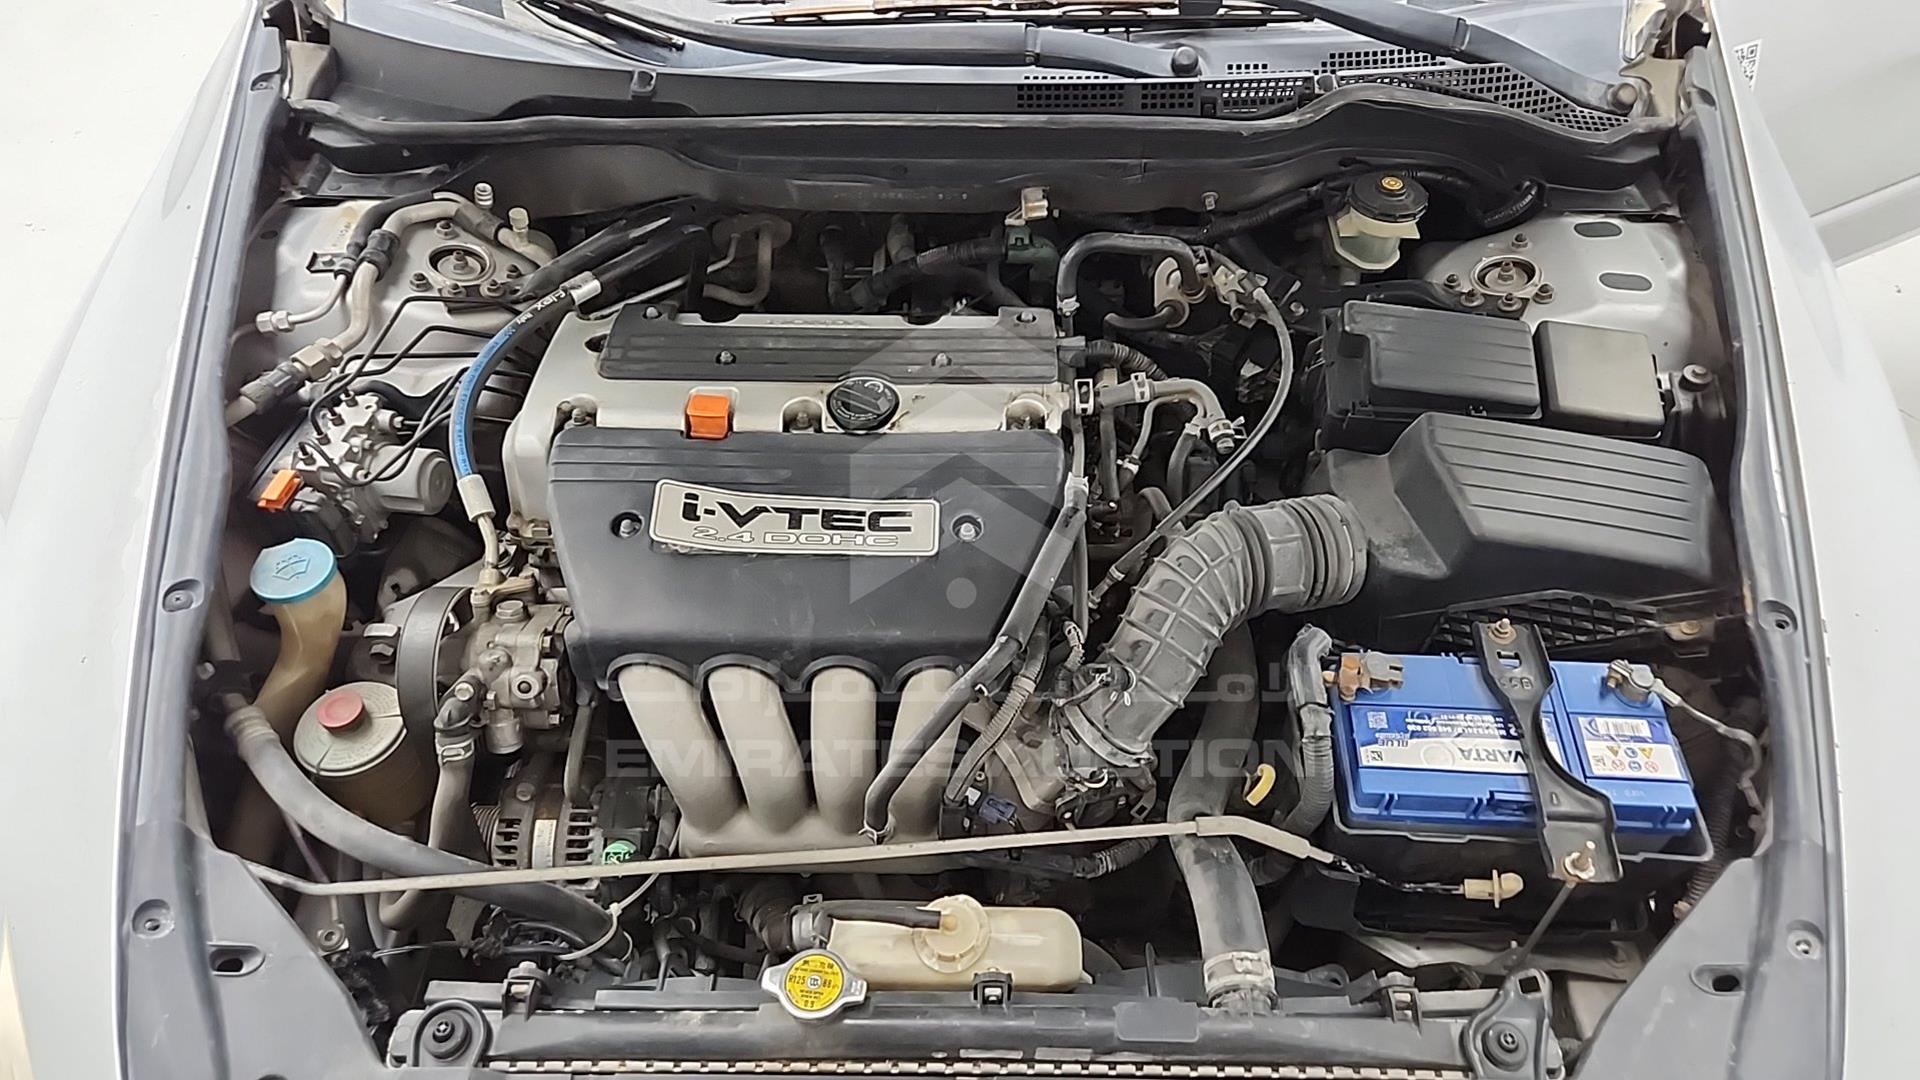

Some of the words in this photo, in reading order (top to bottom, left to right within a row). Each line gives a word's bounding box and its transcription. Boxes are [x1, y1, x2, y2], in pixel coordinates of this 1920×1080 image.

[682, 492, 913, 532] i-VTEC
[692, 526, 754, 543] 2.4
[763, 531, 899, 546] DOHC
[1457, 747, 1526, 763] VARTA
